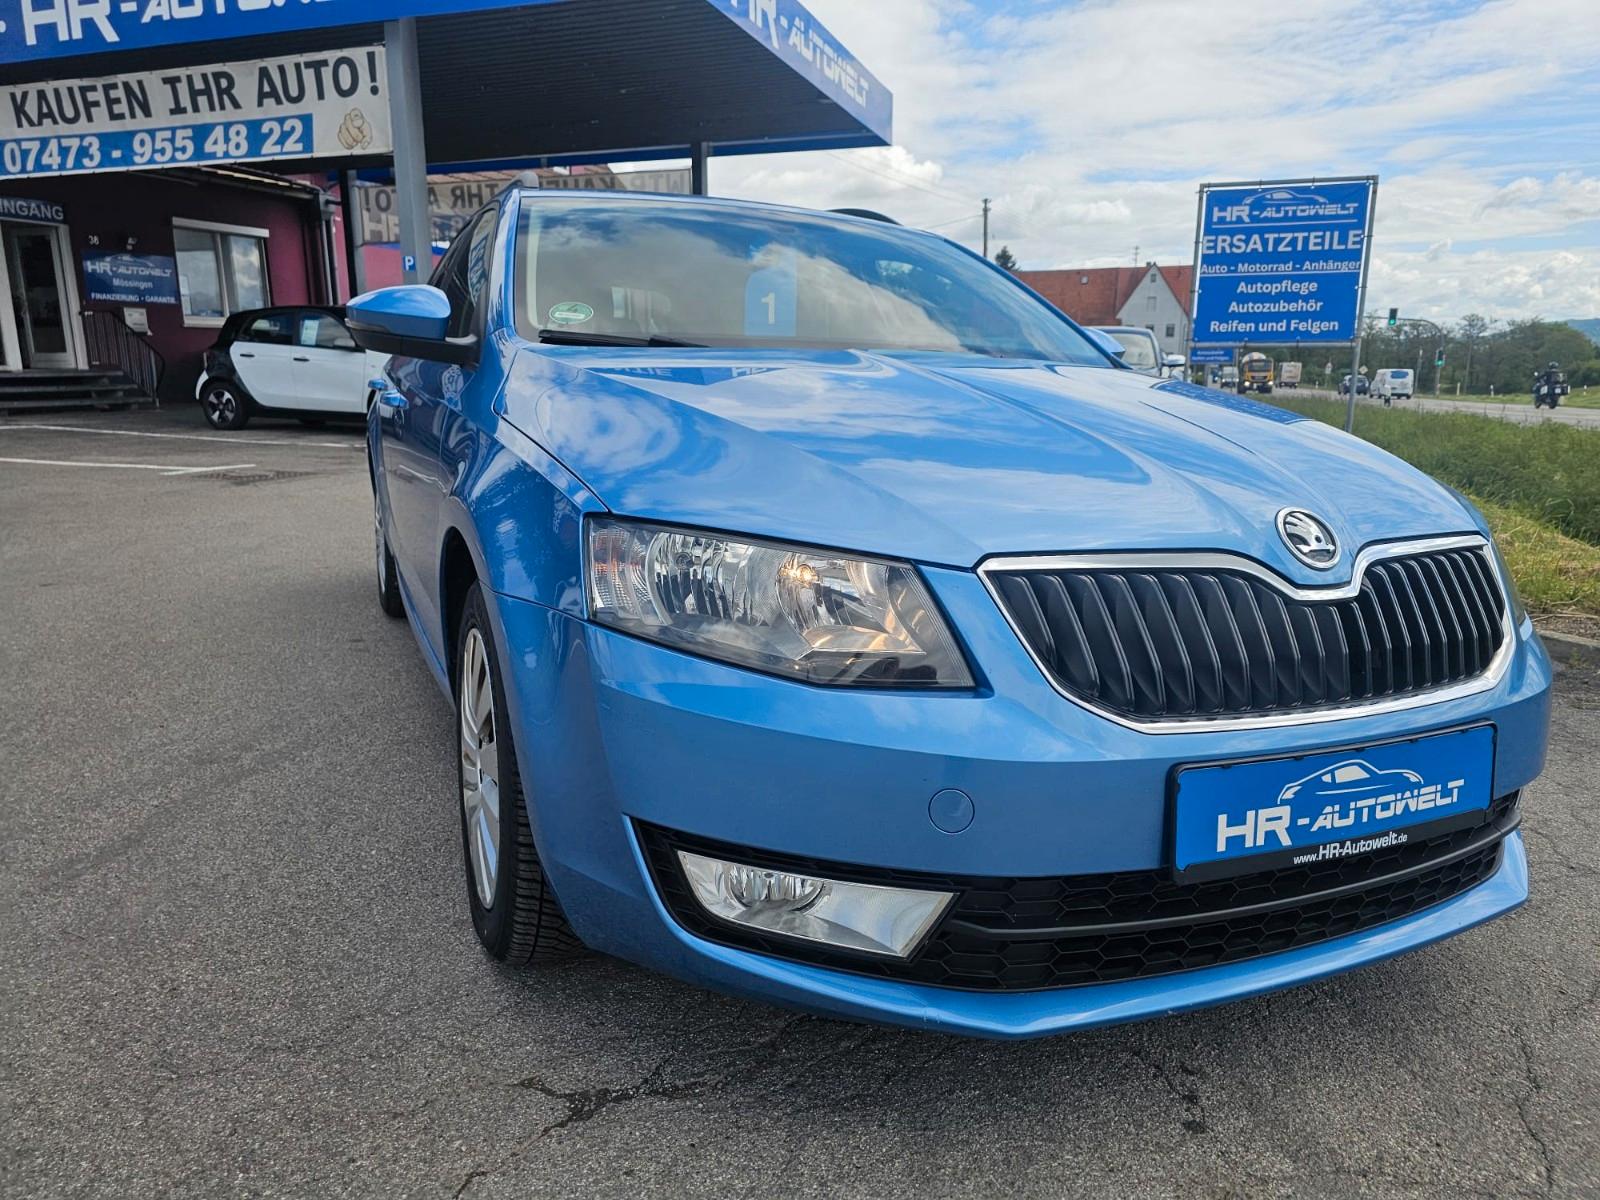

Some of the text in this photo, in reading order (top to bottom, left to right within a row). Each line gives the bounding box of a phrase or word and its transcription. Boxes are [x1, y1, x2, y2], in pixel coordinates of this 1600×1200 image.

[10, 51, 380, 129] KAUFEN IHR AUTO!
[3, 136, 101, 174] 07473
[132, 129, 194, 165] 955
[204, 124, 248, 158] 48
[261, 118, 303, 154] 22
[1212, 203, 1359, 223] HR-AUTOWELT
[1201, 230, 1363, 255] ERSATZTEILE
[1201, 264, 1228, 274] Auto
[1237, 261, 1293, 273] Motorrad
[1302, 260, 1361, 272] Anhänger
[1236, 280, 1318, 296] Autopflege
[760, 292, 776, 325] 1
[1228, 299, 1324, 313] Autozubehör
[1210, 319, 1339, 335] Reifen und Felgen
[1216, 779, 1465, 853] HR-AUTOWELT
[1293, 832, 1409, 865] www.HR-Autowelt.de
